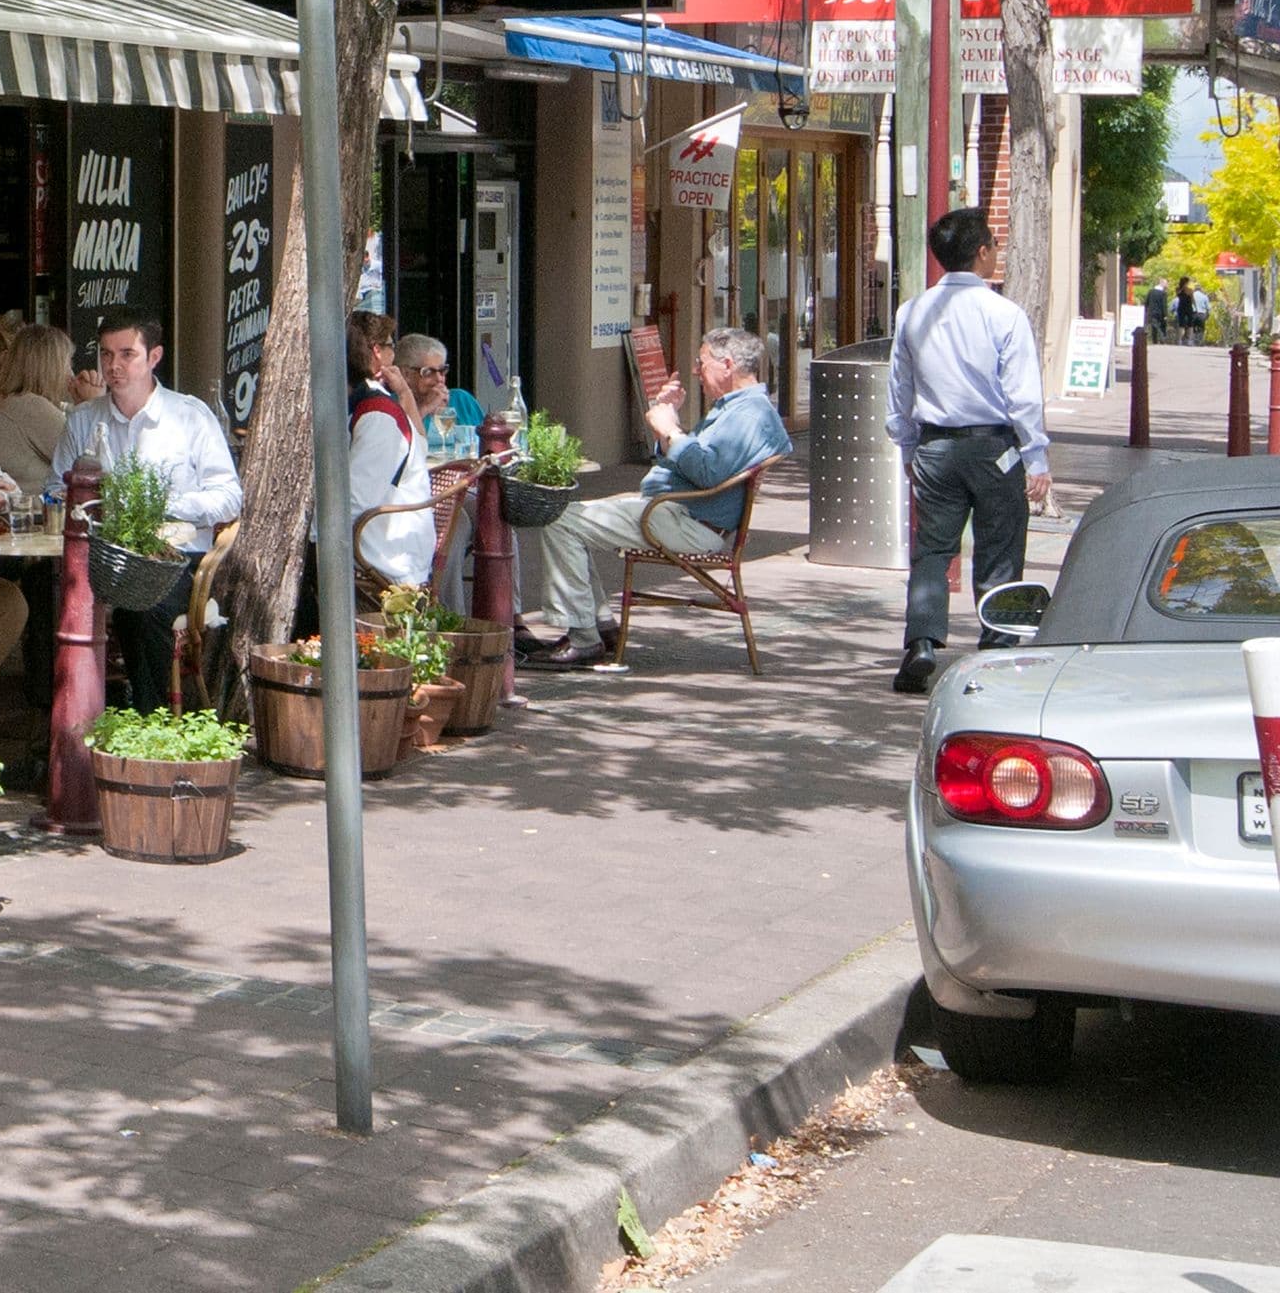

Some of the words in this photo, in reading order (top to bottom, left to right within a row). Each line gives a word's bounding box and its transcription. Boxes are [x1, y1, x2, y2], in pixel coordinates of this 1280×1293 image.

[818, 49, 871, 62] HERBAL
[650, 54, 674, 75] DRY
[677, 60, 735, 85] CLEANERS
[817, 68, 895, 83] OSTEOPATH
[77, 149, 131, 206] VILLA
[225, 163, 268, 215] BAILEYS
[669, 169, 730, 188] PRACTICE
[678, 190, 714, 207] OPEN
[73, 218, 141, 272] MARIA
[227, 278, 260, 323] PETER
[1121, 794, 1159, 809] SP
